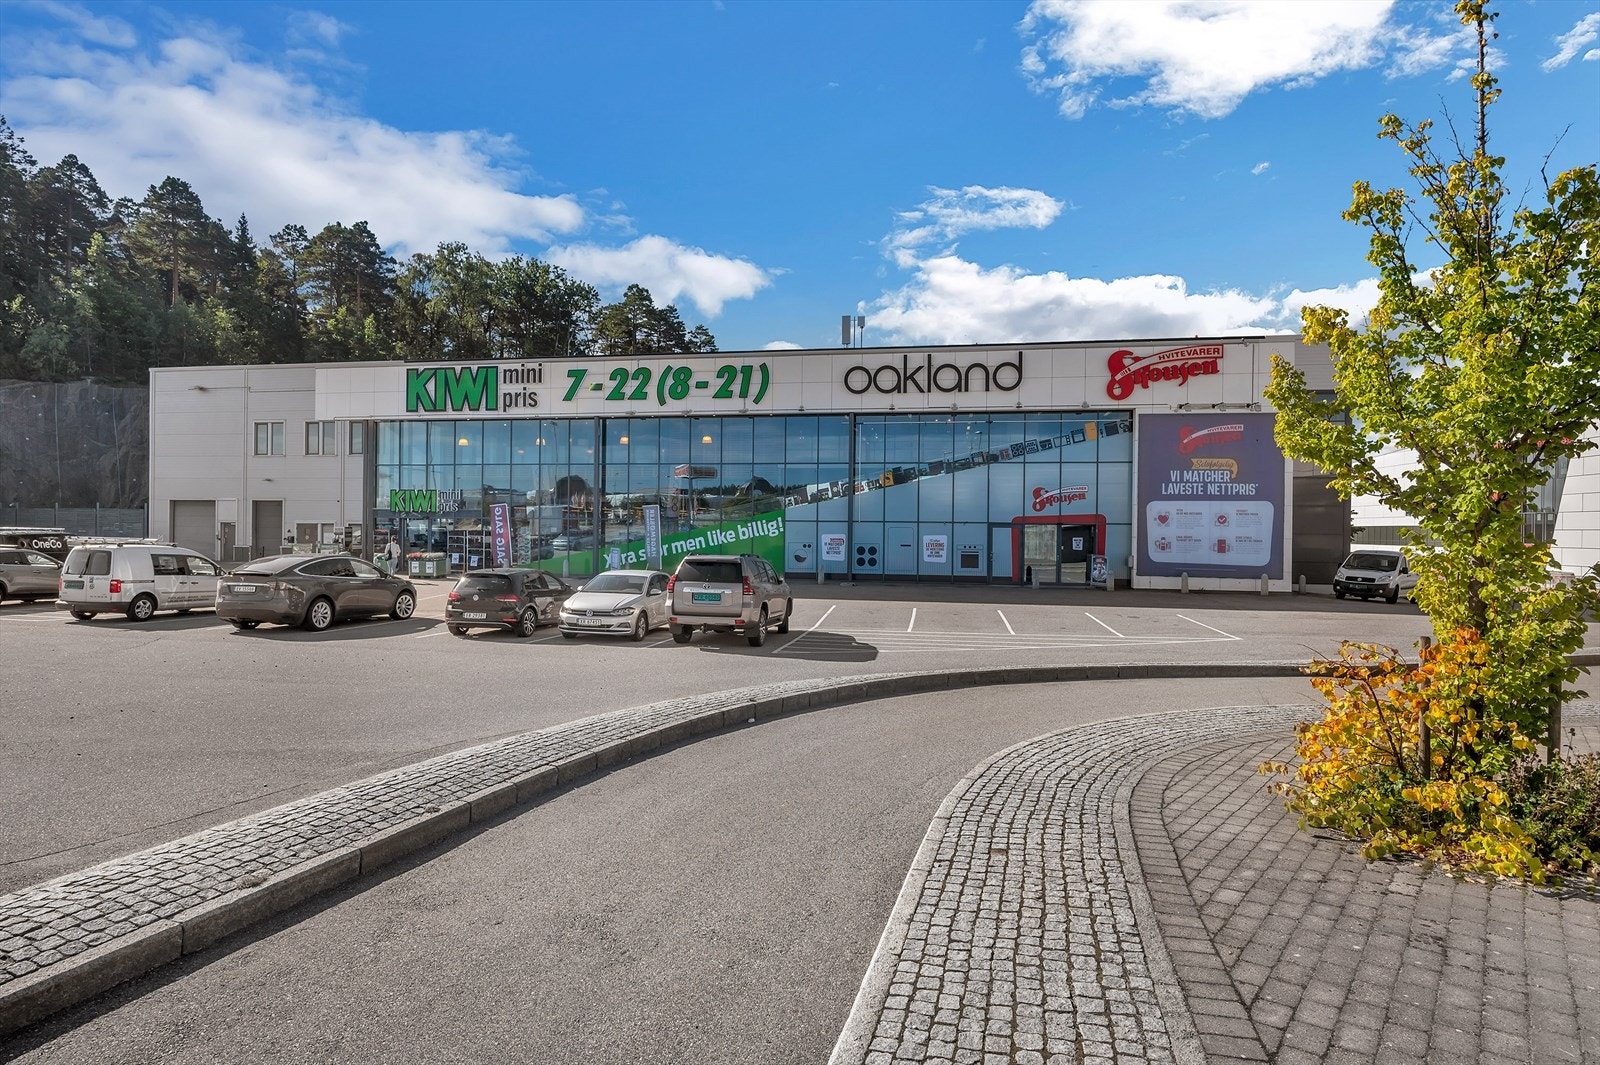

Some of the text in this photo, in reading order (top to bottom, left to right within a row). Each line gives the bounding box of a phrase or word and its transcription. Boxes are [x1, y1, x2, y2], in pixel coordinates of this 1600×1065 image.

[1158, 347, 1220, 361] HVITEVARER
[503, 363, 543, 384] mini
[844, 351, 1023, 395] oakland
[1107, 350, 1220, 401] Skousen
[406, 366, 498, 412] KIWI
[503, 386, 538, 412] pris
[1170, 470, 1231, 483] VI MATCHER
[1161, 483, 1204, 495] LAVESTE
[390, 489, 438, 513] KIWI
[438, 500, 459, 514] pris
[32, 539, 62, 549] OneCo
[671, 536, 706, 555] men
[707, 529, 736, 547] like
[737, 516, 785, 540] billig!
